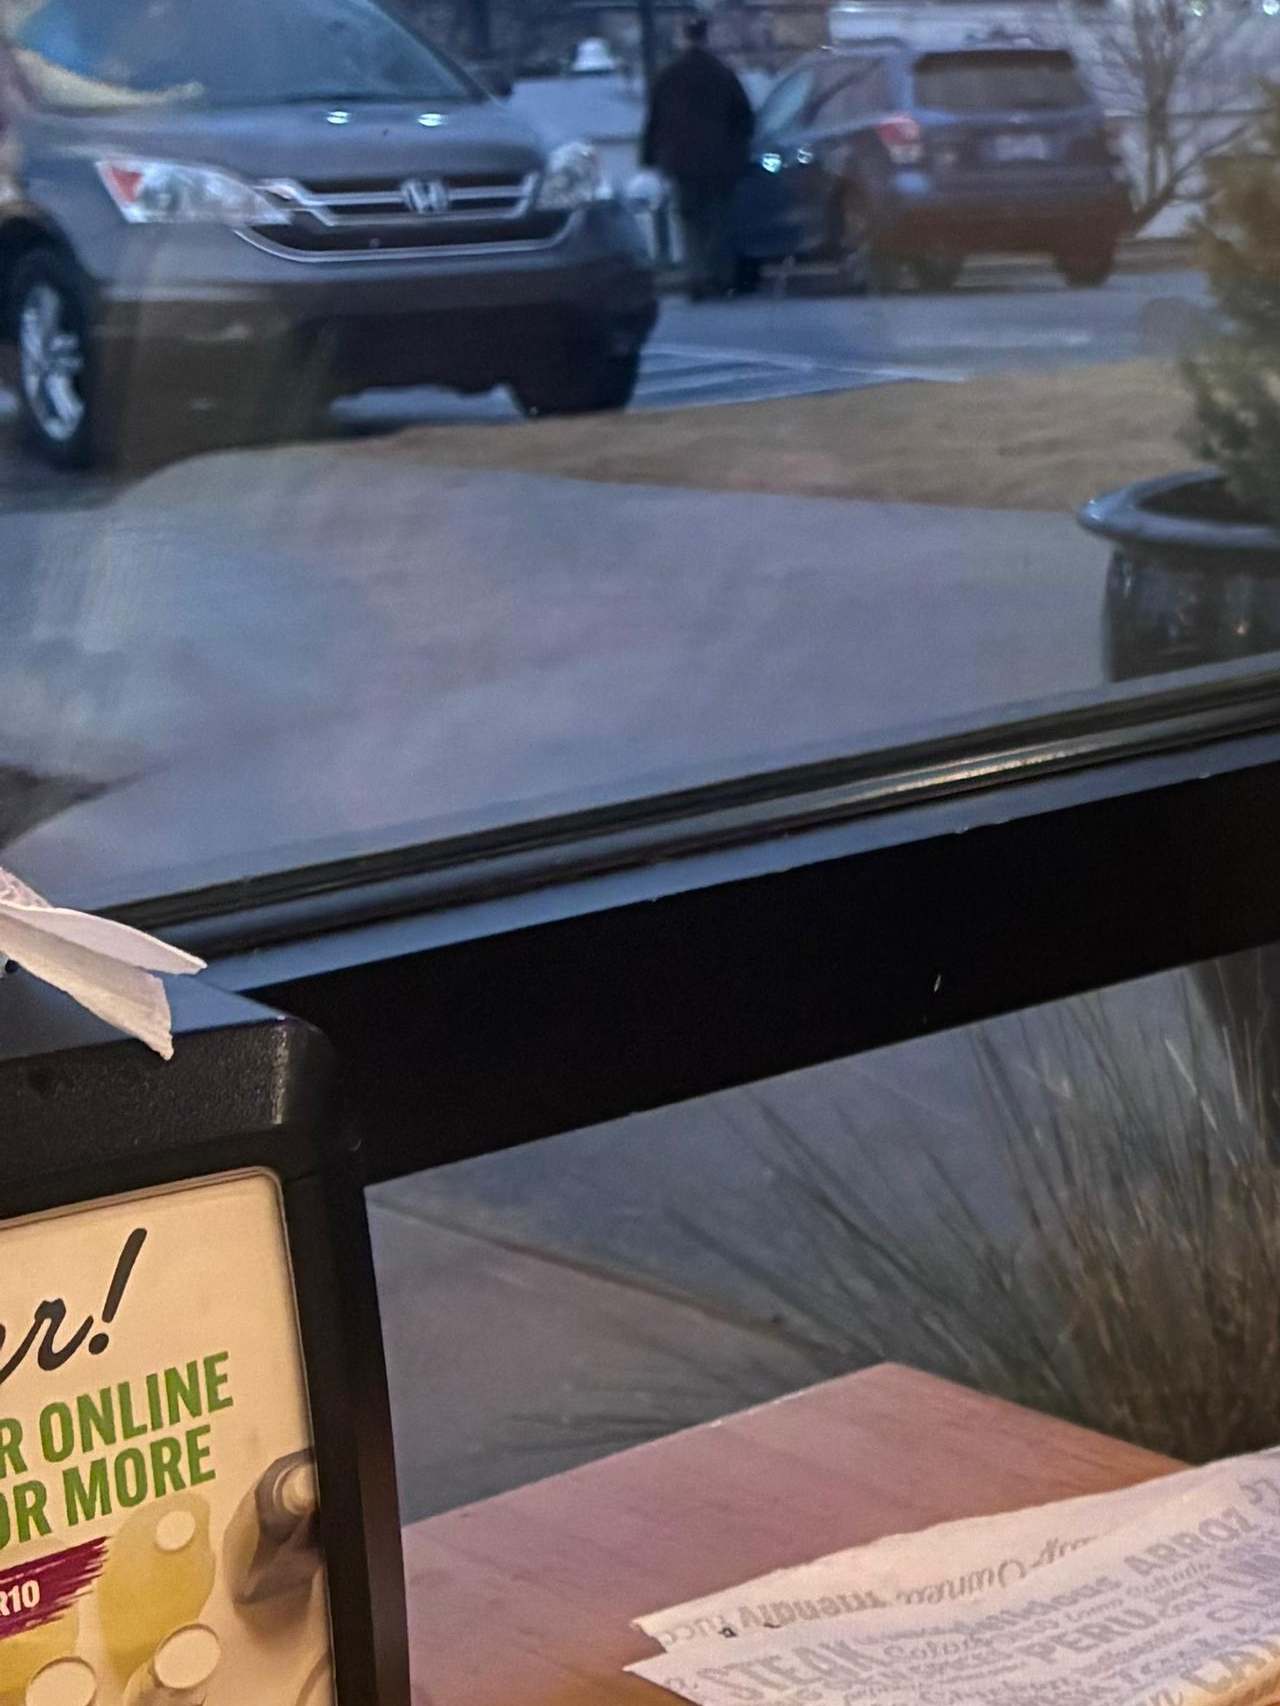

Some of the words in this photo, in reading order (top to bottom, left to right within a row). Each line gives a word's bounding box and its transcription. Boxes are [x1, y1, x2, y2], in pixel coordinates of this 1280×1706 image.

[0, 1227, 148, 1385] r!
[38, 1350, 234, 1463] ONLINE
[62, 1424, 217, 1527] MORE
[697, 1638, 892, 1699] STEAK
[1123, 1506, 1263, 1577] ARROZ
[1018, 1608, 1159, 1663] PERU
